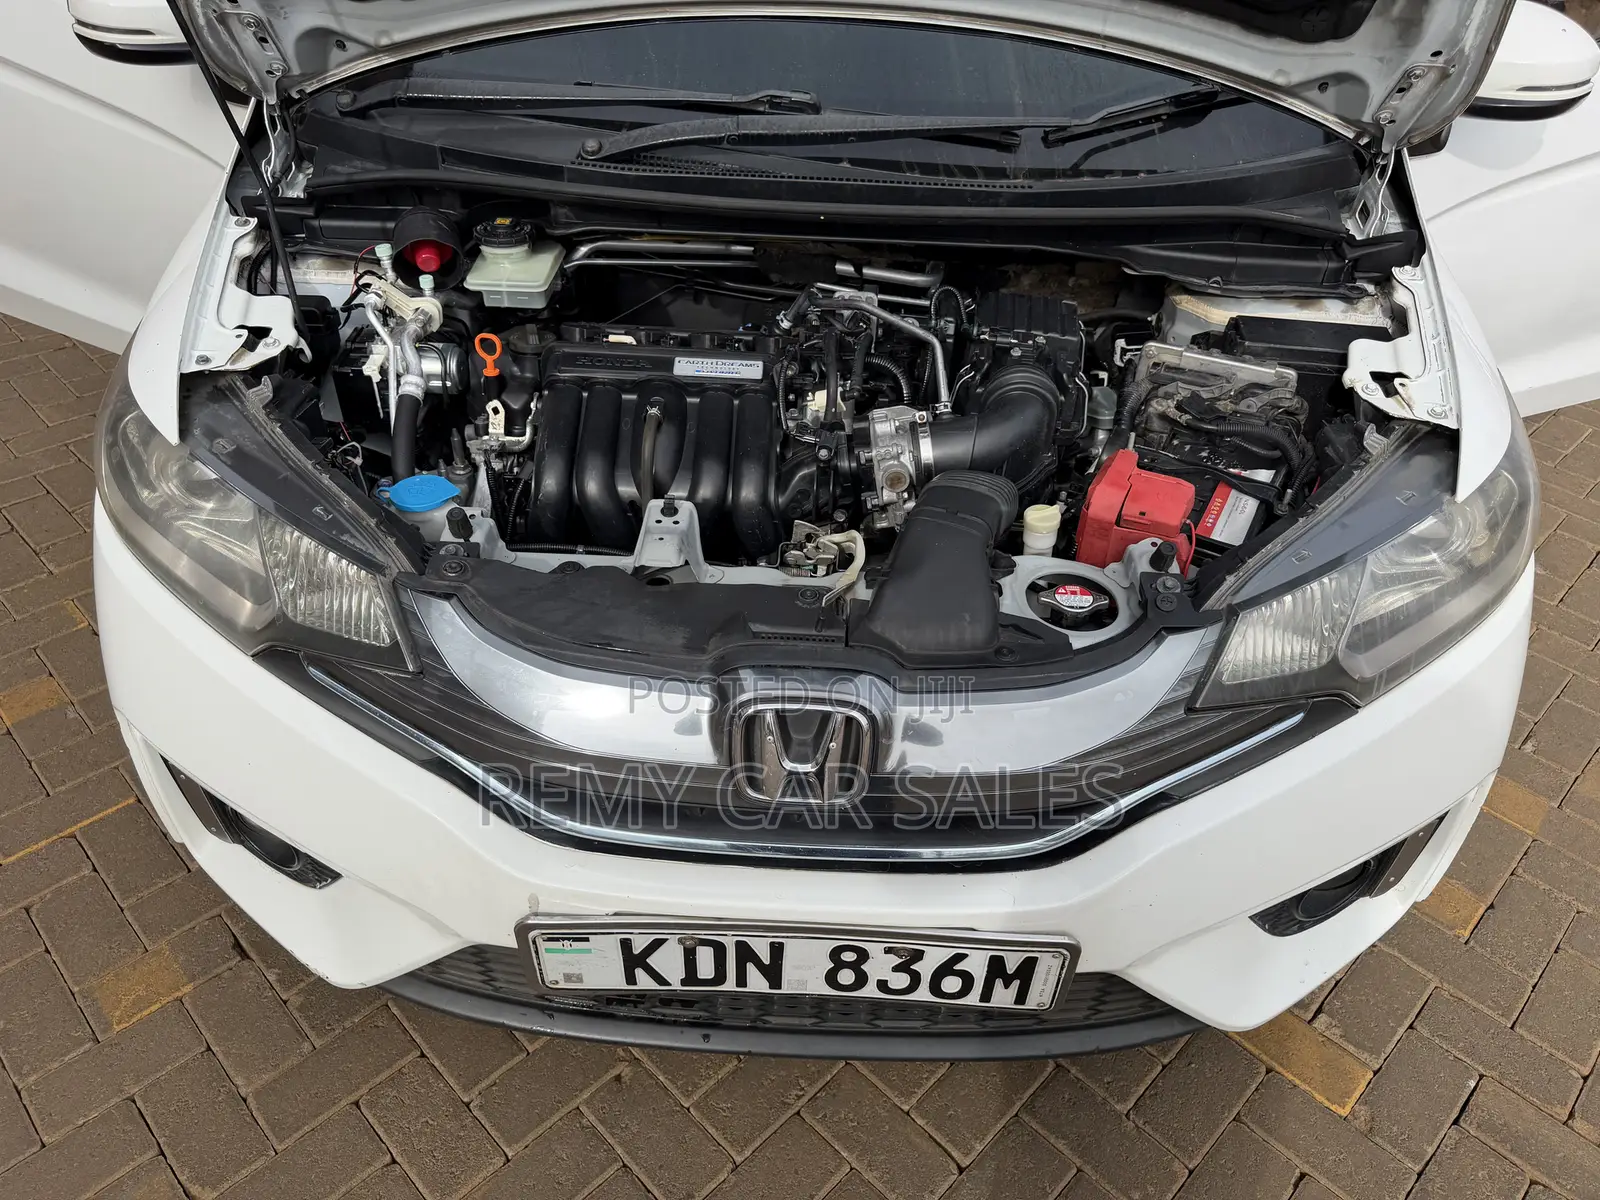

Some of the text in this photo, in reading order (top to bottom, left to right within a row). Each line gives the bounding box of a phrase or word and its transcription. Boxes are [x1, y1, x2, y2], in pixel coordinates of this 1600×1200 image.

[575, 356, 653, 368] HONDA
[677, 359, 761, 369] EARTH DREAMS
[620, 936, 785, 990] KDN
[823, 943, 1039, 1006] 836M
